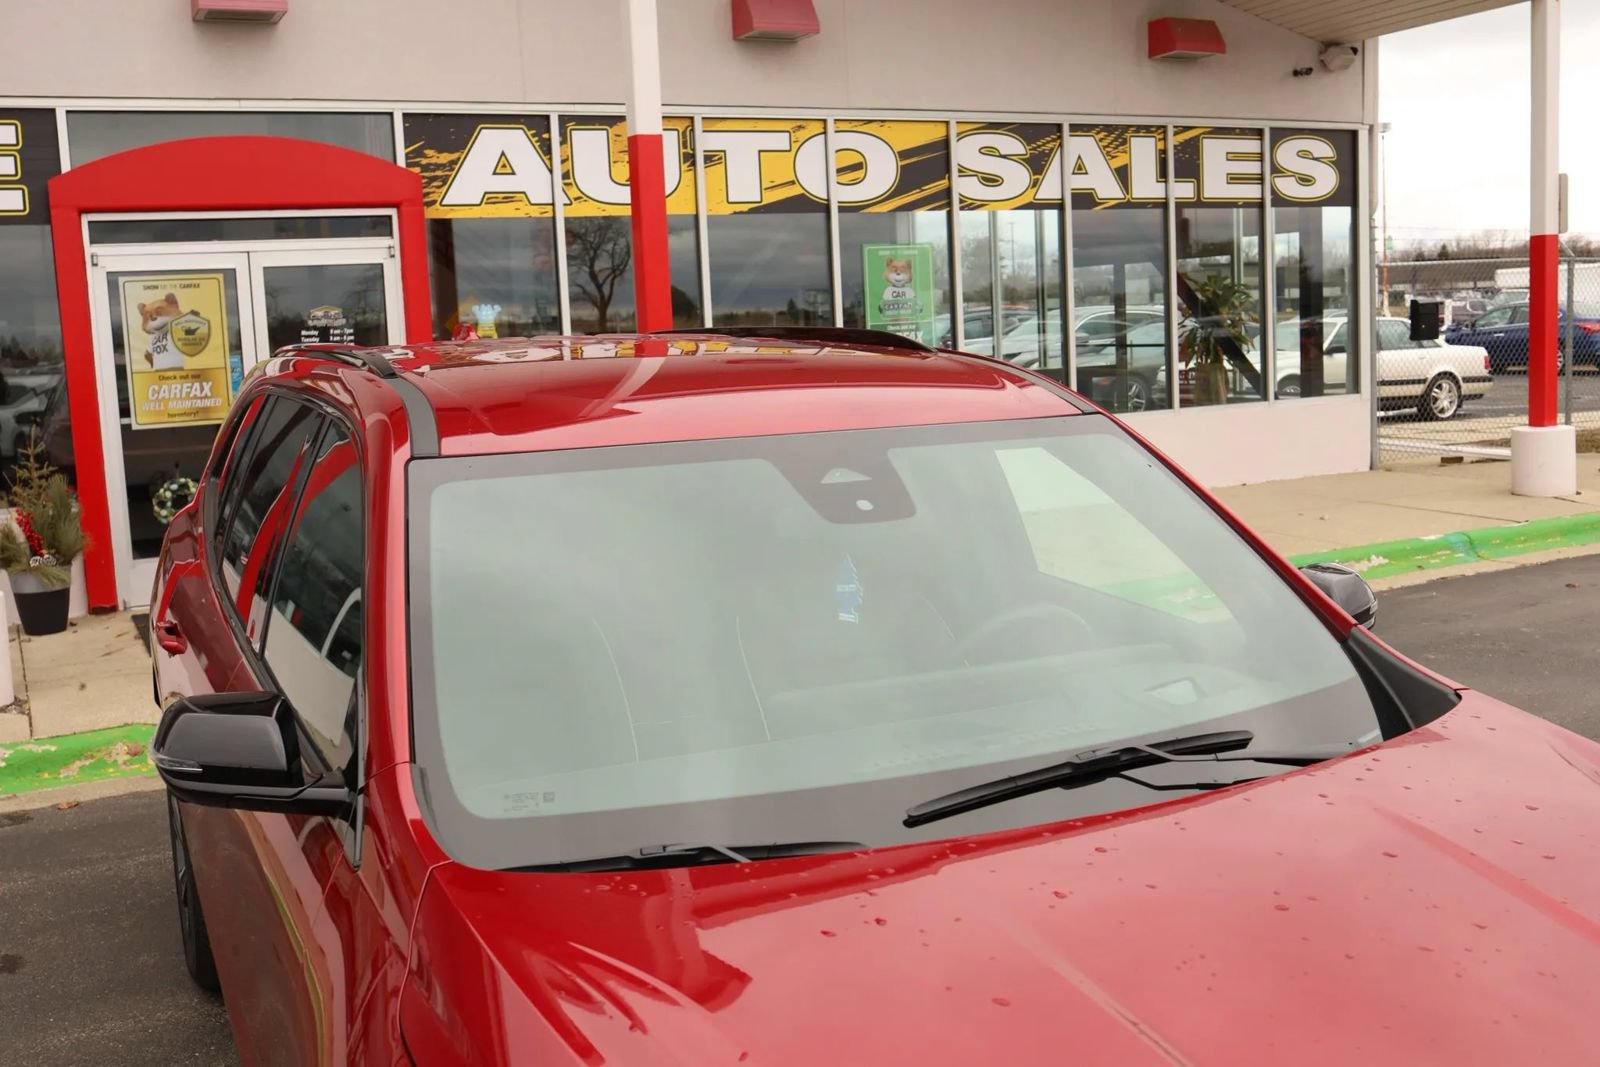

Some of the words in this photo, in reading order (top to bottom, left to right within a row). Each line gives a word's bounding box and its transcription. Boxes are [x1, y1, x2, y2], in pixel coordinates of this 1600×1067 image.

[439, 125, 899, 206] AUTO
[956, 131, 1340, 202] SALES
[891, 290, 906, 299] CAR
[153, 344, 169, 355] FOX
[148, 381, 212, 400] CARFAX
[142, 400, 165, 411] WELL
[168, 397, 222, 409] MAINTAINED
